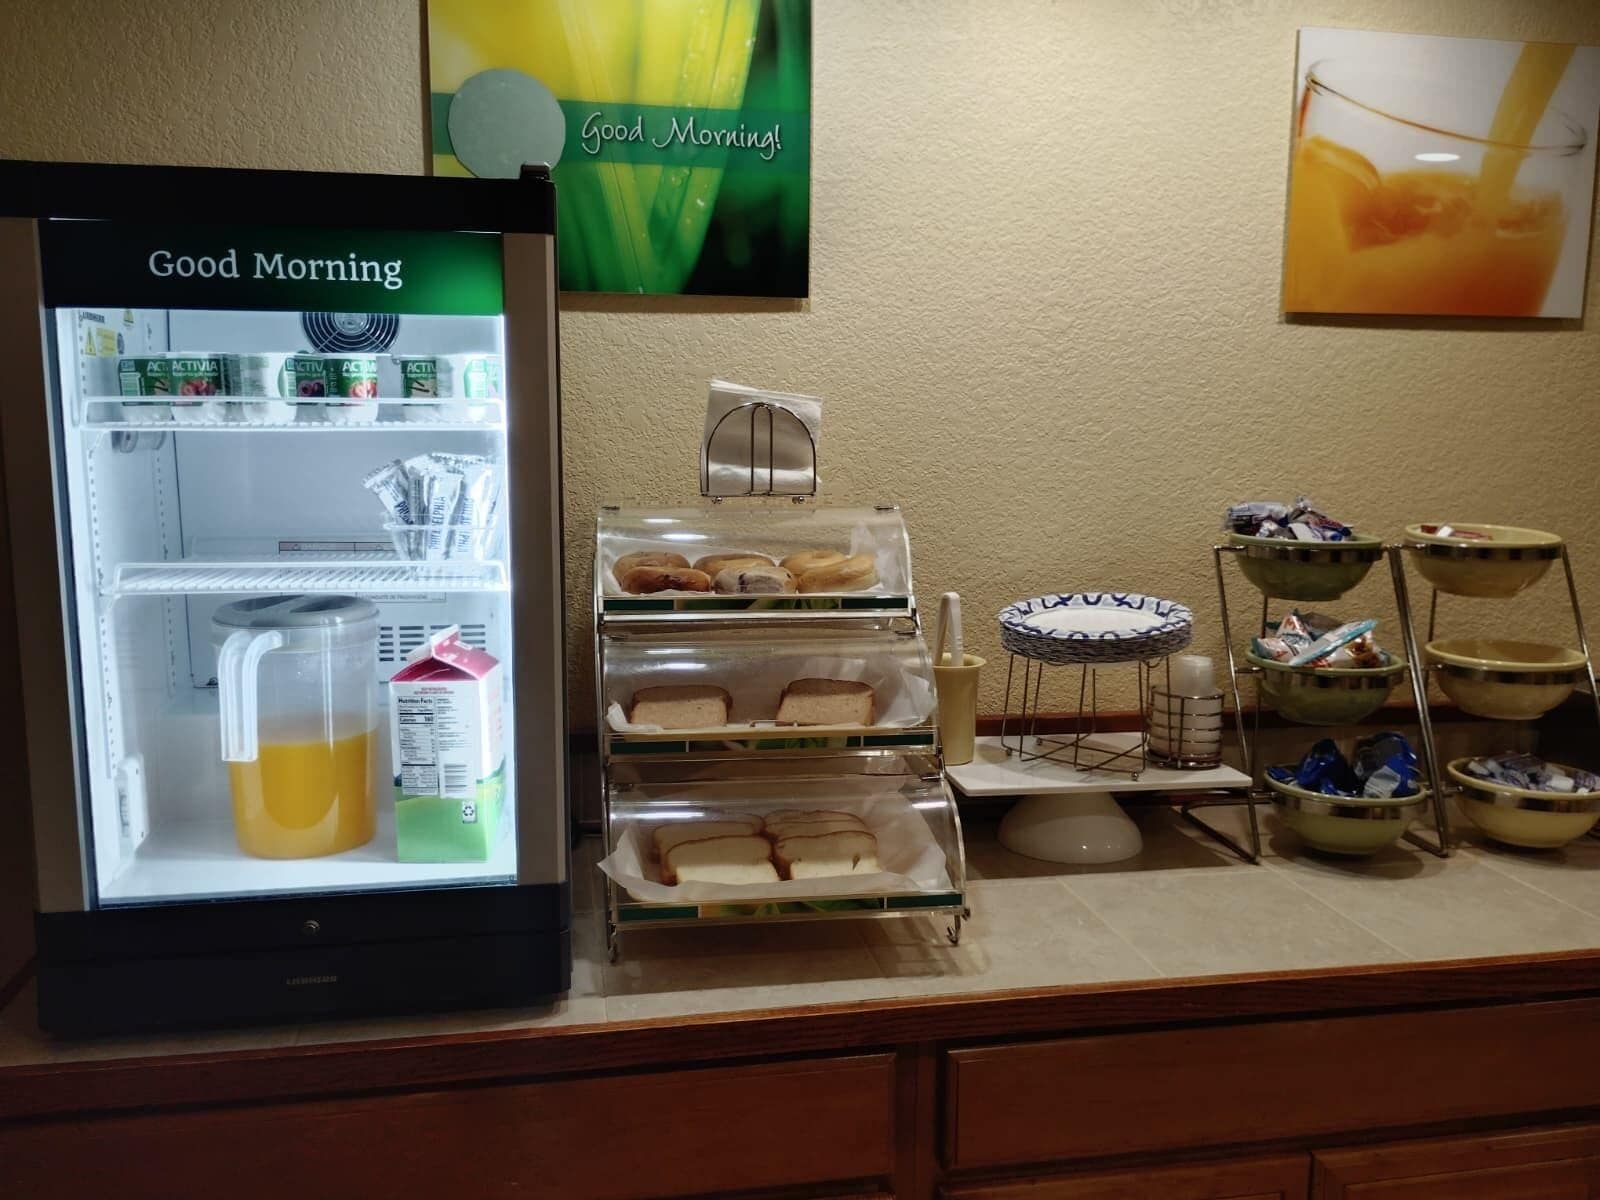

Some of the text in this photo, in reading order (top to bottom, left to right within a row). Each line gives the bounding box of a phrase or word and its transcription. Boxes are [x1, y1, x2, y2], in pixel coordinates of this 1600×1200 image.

[581, 112, 782, 160] Good Morning!
[148, 249, 403, 290] Good Morning
[172, 360, 218, 371] ACTIVIA
[428, 496, 446, 549] PHILAELPHIA
